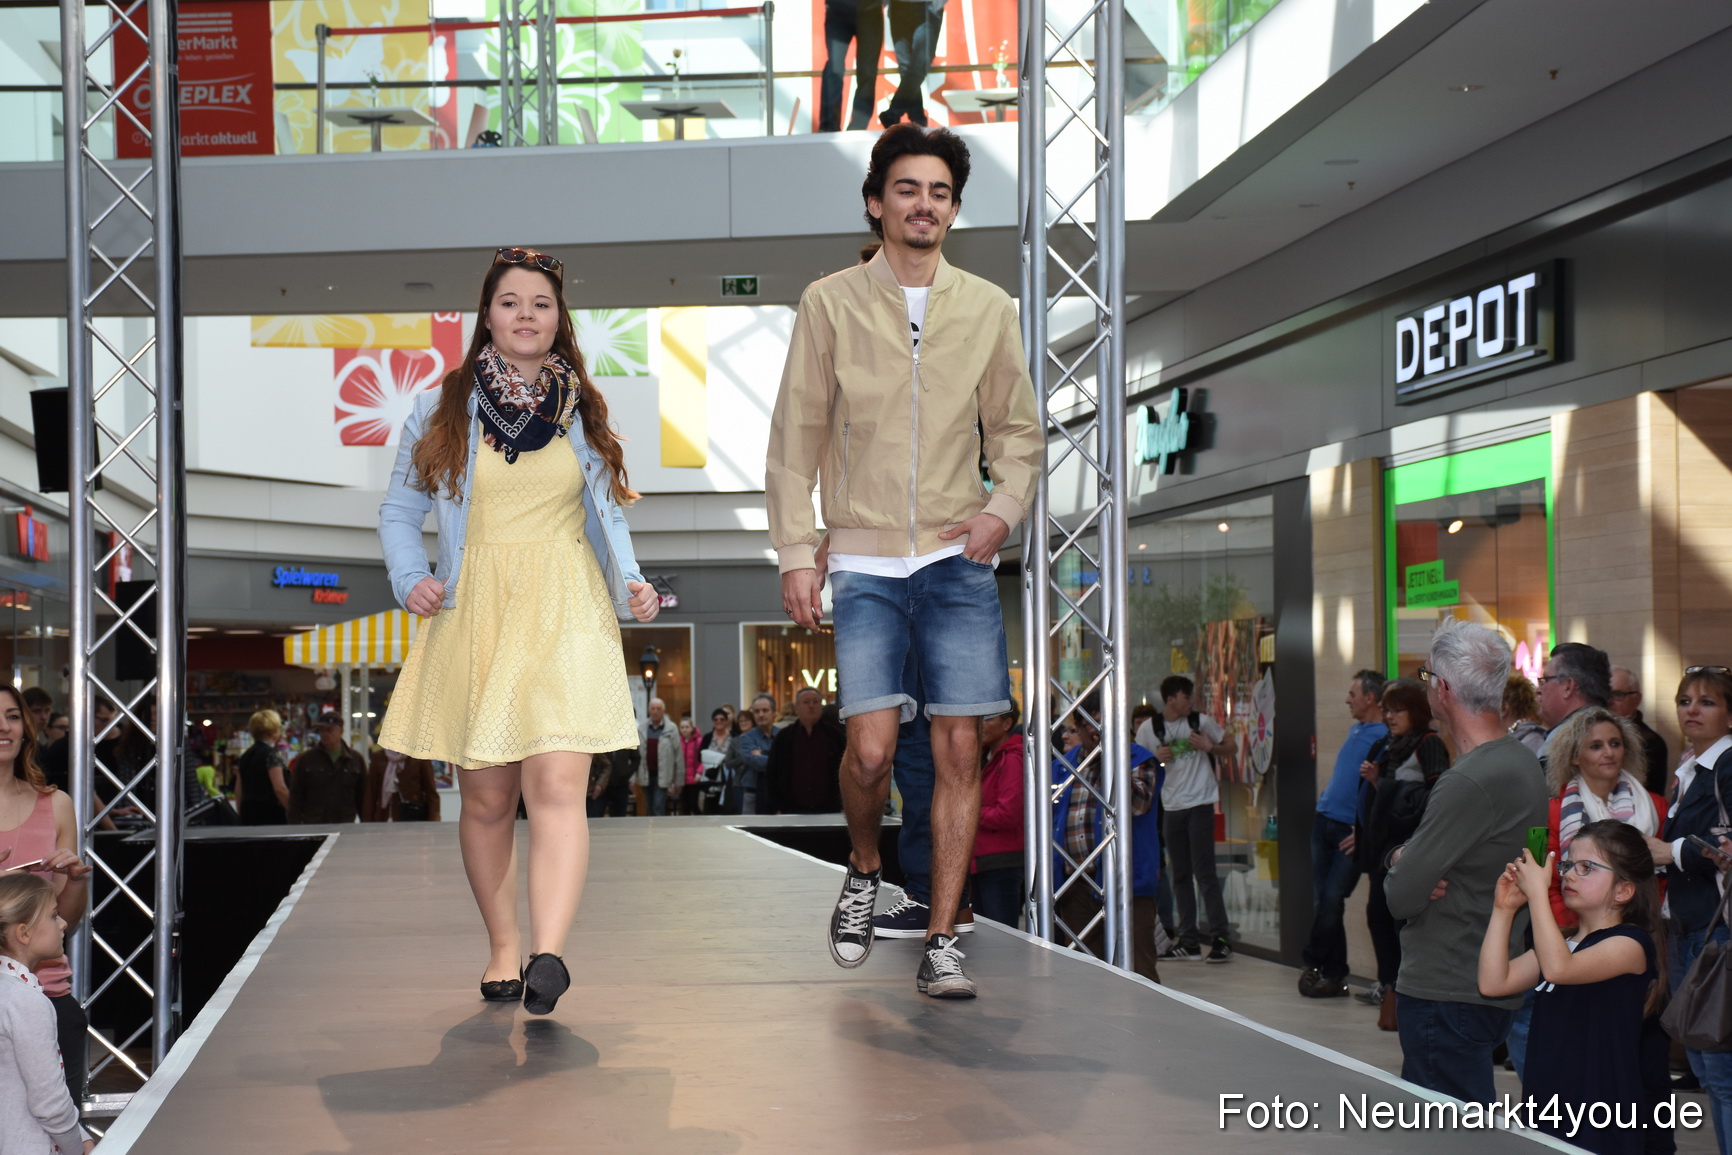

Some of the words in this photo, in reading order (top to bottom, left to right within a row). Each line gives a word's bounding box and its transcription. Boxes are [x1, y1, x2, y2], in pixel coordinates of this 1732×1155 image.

[178, 35, 238, 50] erMarkt
[133, 83, 253, 110] CEPLEX
[1396, 272, 1536, 384] DEPOT
[274, 566, 338, 588] Spielwaren
